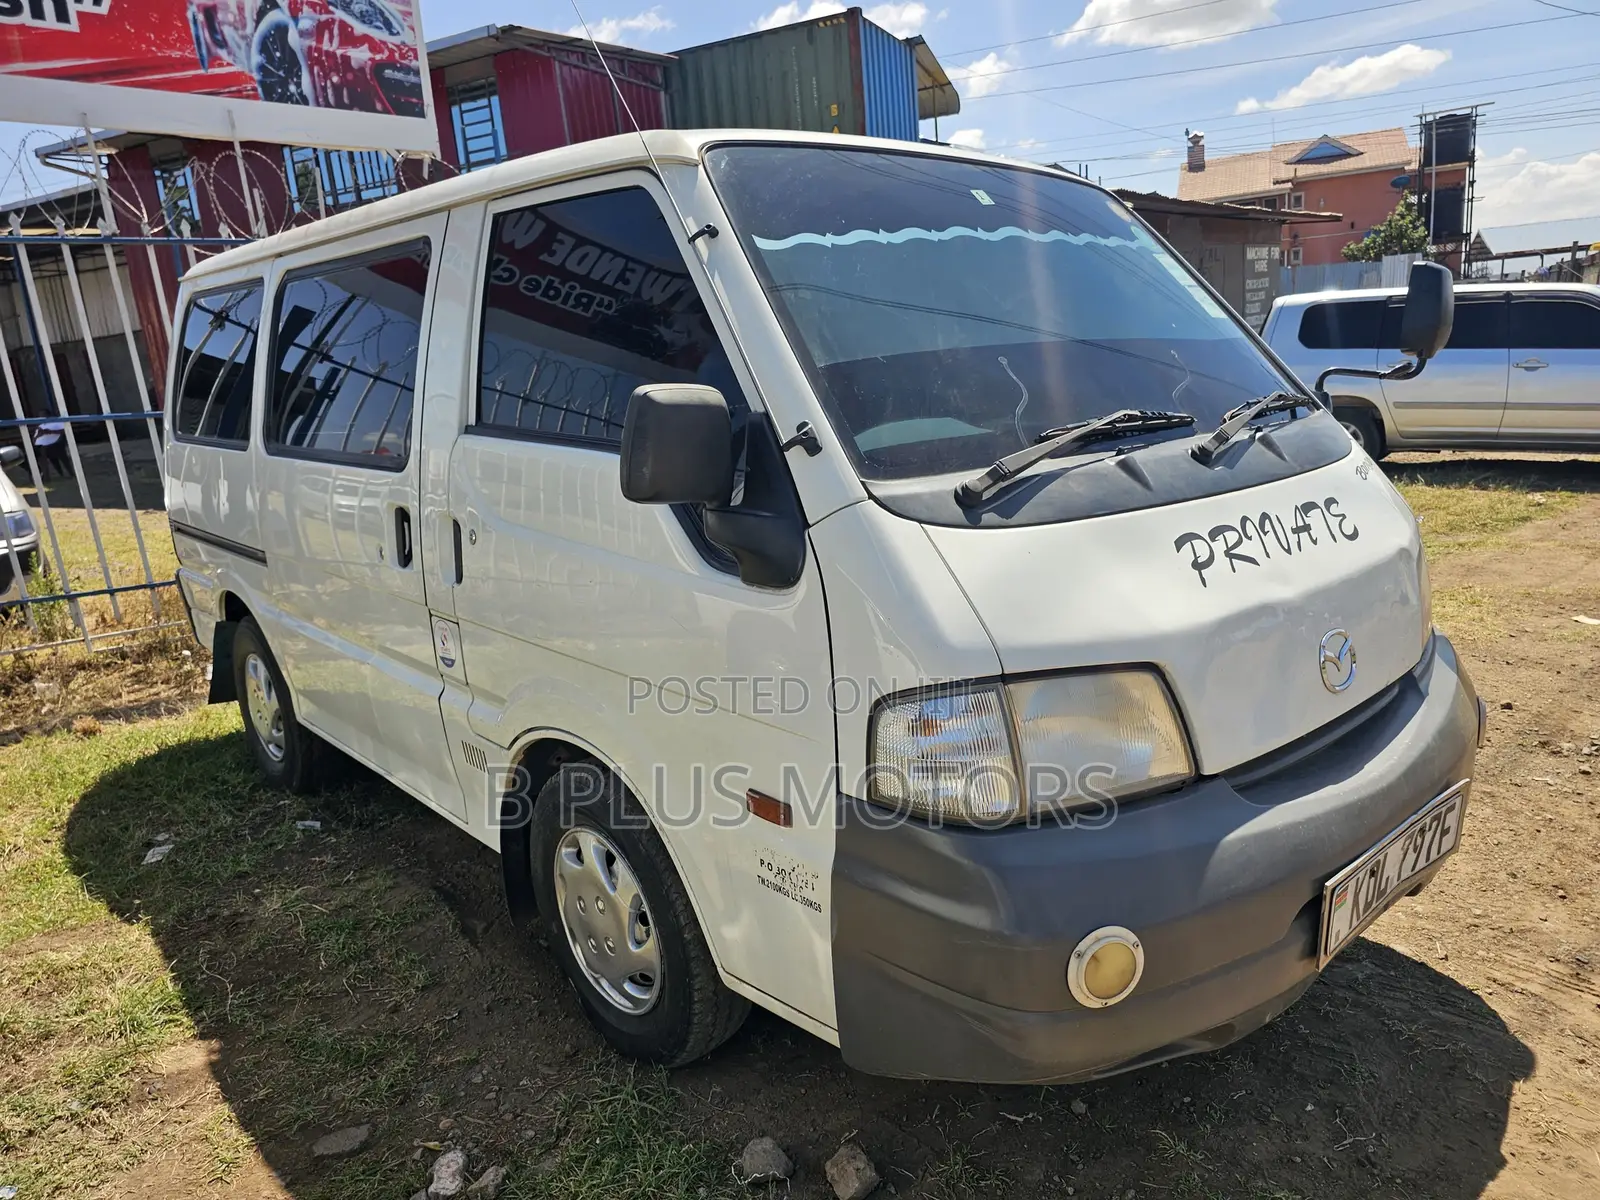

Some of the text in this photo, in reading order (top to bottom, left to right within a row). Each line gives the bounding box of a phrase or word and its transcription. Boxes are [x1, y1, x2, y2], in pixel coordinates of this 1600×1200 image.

[1246, 246, 1269, 260] MACHINE
[1254, 260, 1268, 272] HIRE
[1173, 496, 1360, 588] PRIVATE
[1349, 802, 1456, 929] KDL 797F
